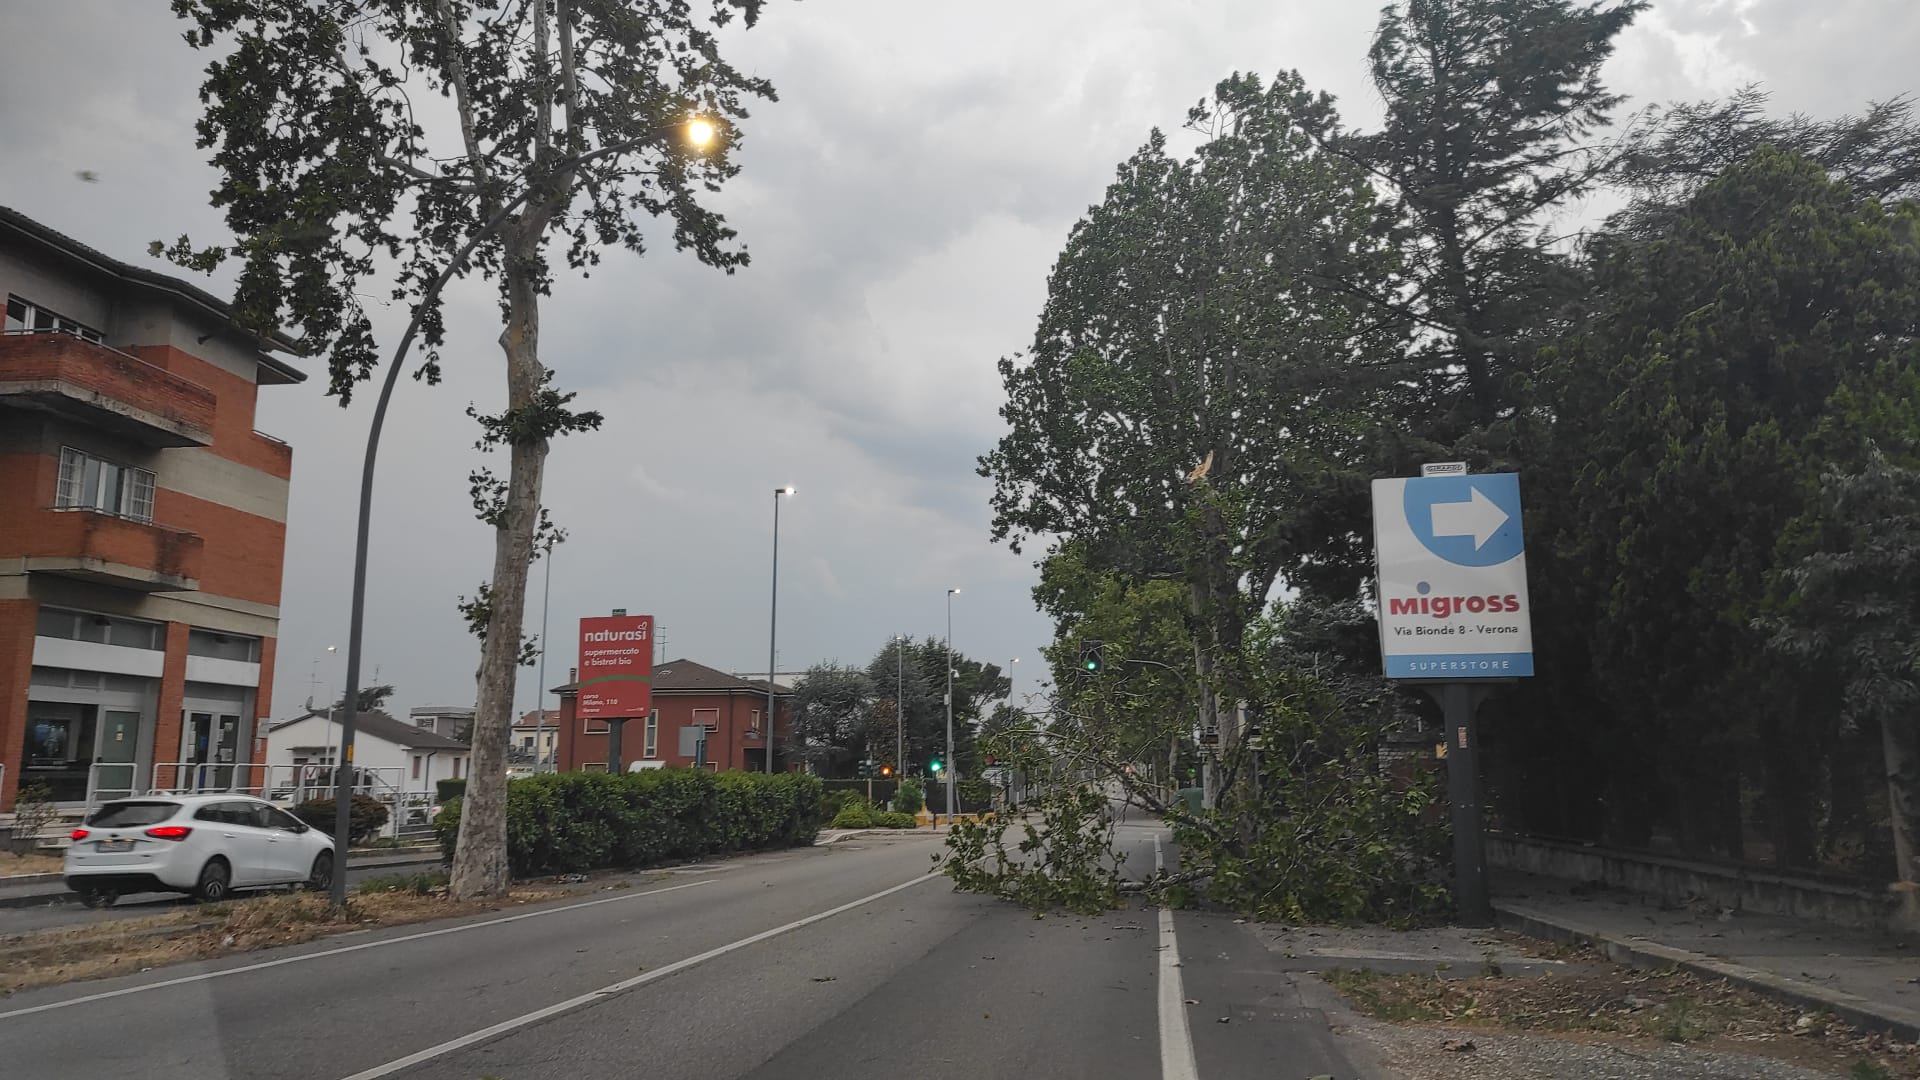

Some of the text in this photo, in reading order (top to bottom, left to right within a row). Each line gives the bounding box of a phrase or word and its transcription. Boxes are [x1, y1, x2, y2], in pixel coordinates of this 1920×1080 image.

[1389, 581, 1520, 618] Migross
[1394, 626, 1412, 636] Via
[1415, 625, 1455, 635] Bionde
[1458, 625, 1466, 634] 8
[1476, 624, 1518, 634] Verona
[584, 647, 640, 657] supermercato
[591, 658, 617, 666] bistrot
[618, 657, 632, 665] bio
[1409, 660, 1510, 671] SUPERSTORE
